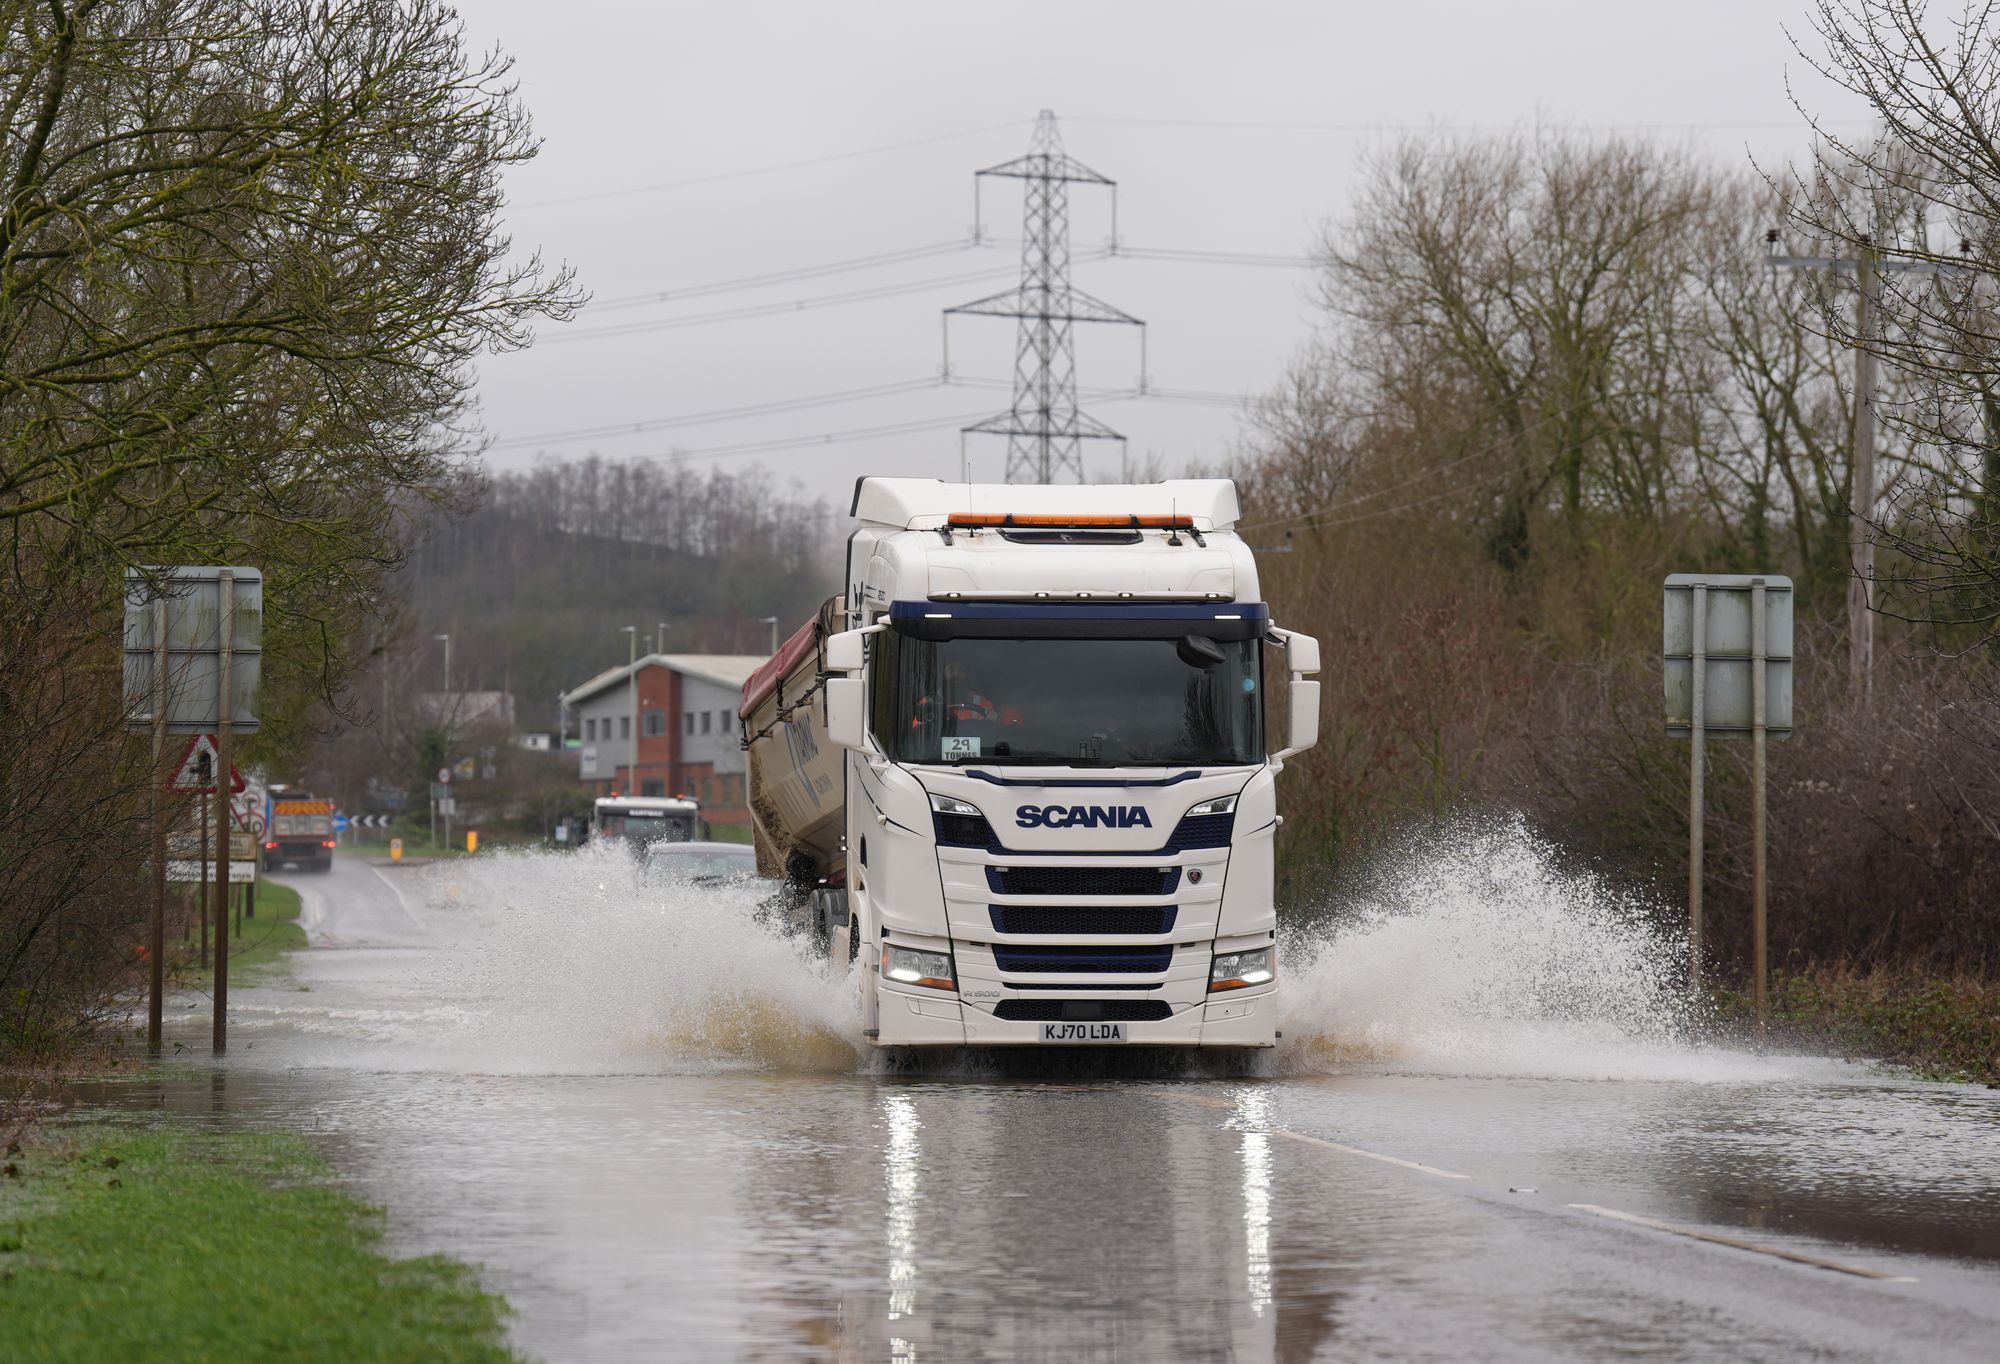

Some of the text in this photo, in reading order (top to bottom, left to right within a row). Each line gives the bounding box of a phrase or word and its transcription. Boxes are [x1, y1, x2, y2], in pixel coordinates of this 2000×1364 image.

[952, 738, 970, 751] 29
[1016, 805, 1153, 828] SCANIA
[1045, 1024, 1121, 1040] KJ70 LDA
